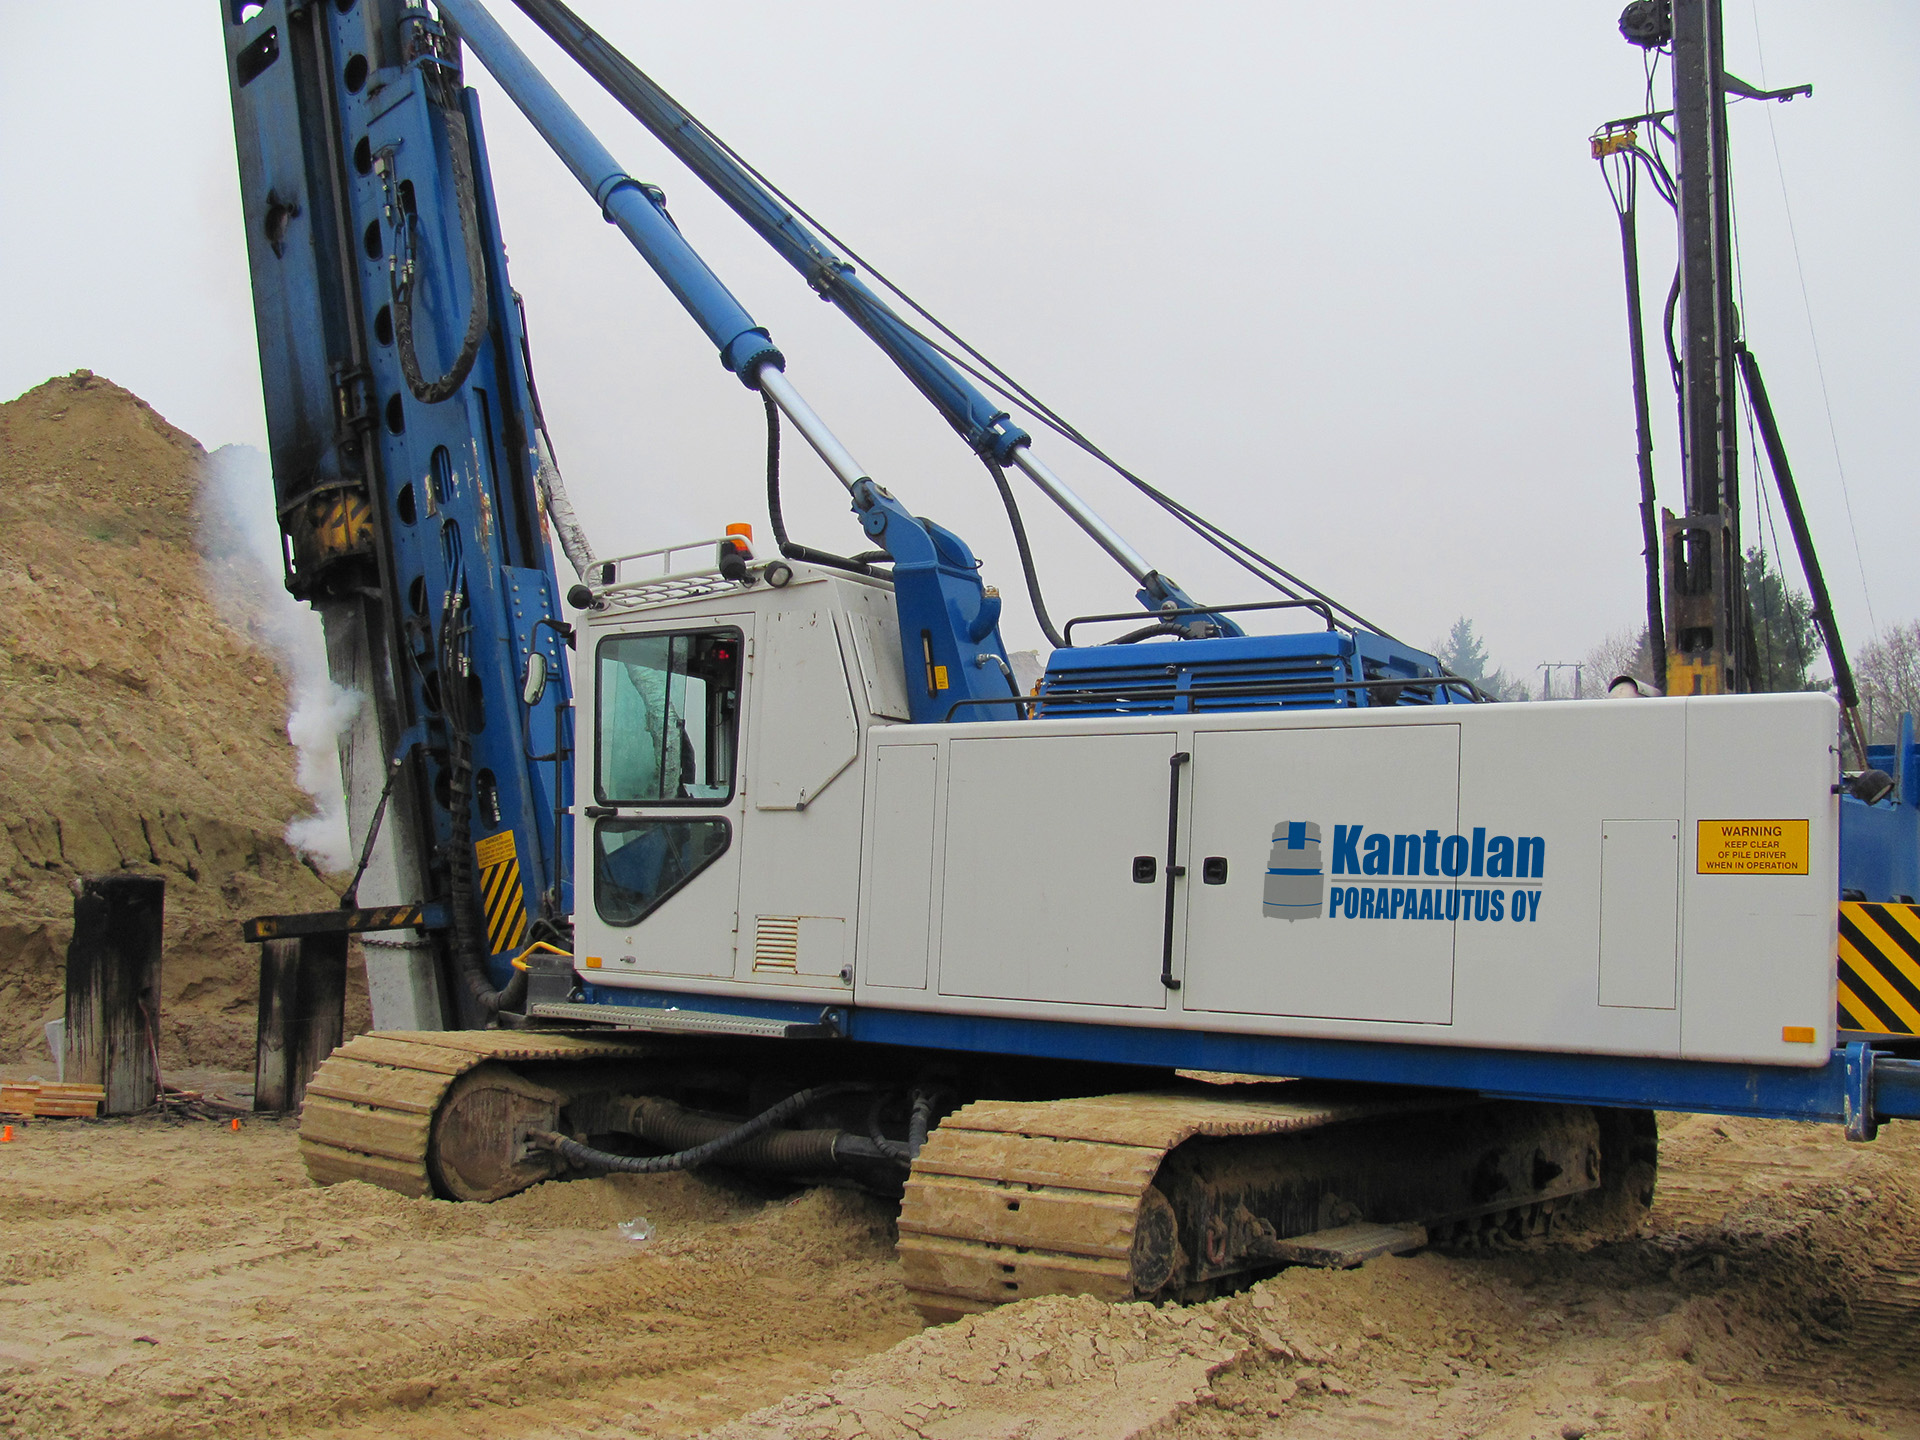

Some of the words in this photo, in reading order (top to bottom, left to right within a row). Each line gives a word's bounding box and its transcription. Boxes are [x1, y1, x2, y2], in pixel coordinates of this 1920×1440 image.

[1721, 826, 1782, 837] WARNING
[1725, 841, 1748, 849] KEEP
[1750, 841, 1780, 849] CLEAR
[1331, 824, 1546, 878] Kantolan
[1718, 851, 1730, 859] OF
[1732, 851, 1751, 859] PILE
[1754, 851, 1787, 859] DRIVER
[1746, 862, 1798, 870] OPERATION
[1329, 886, 1504, 922] PORAPAALUTUS
[1511, 889, 1542, 922] OY
